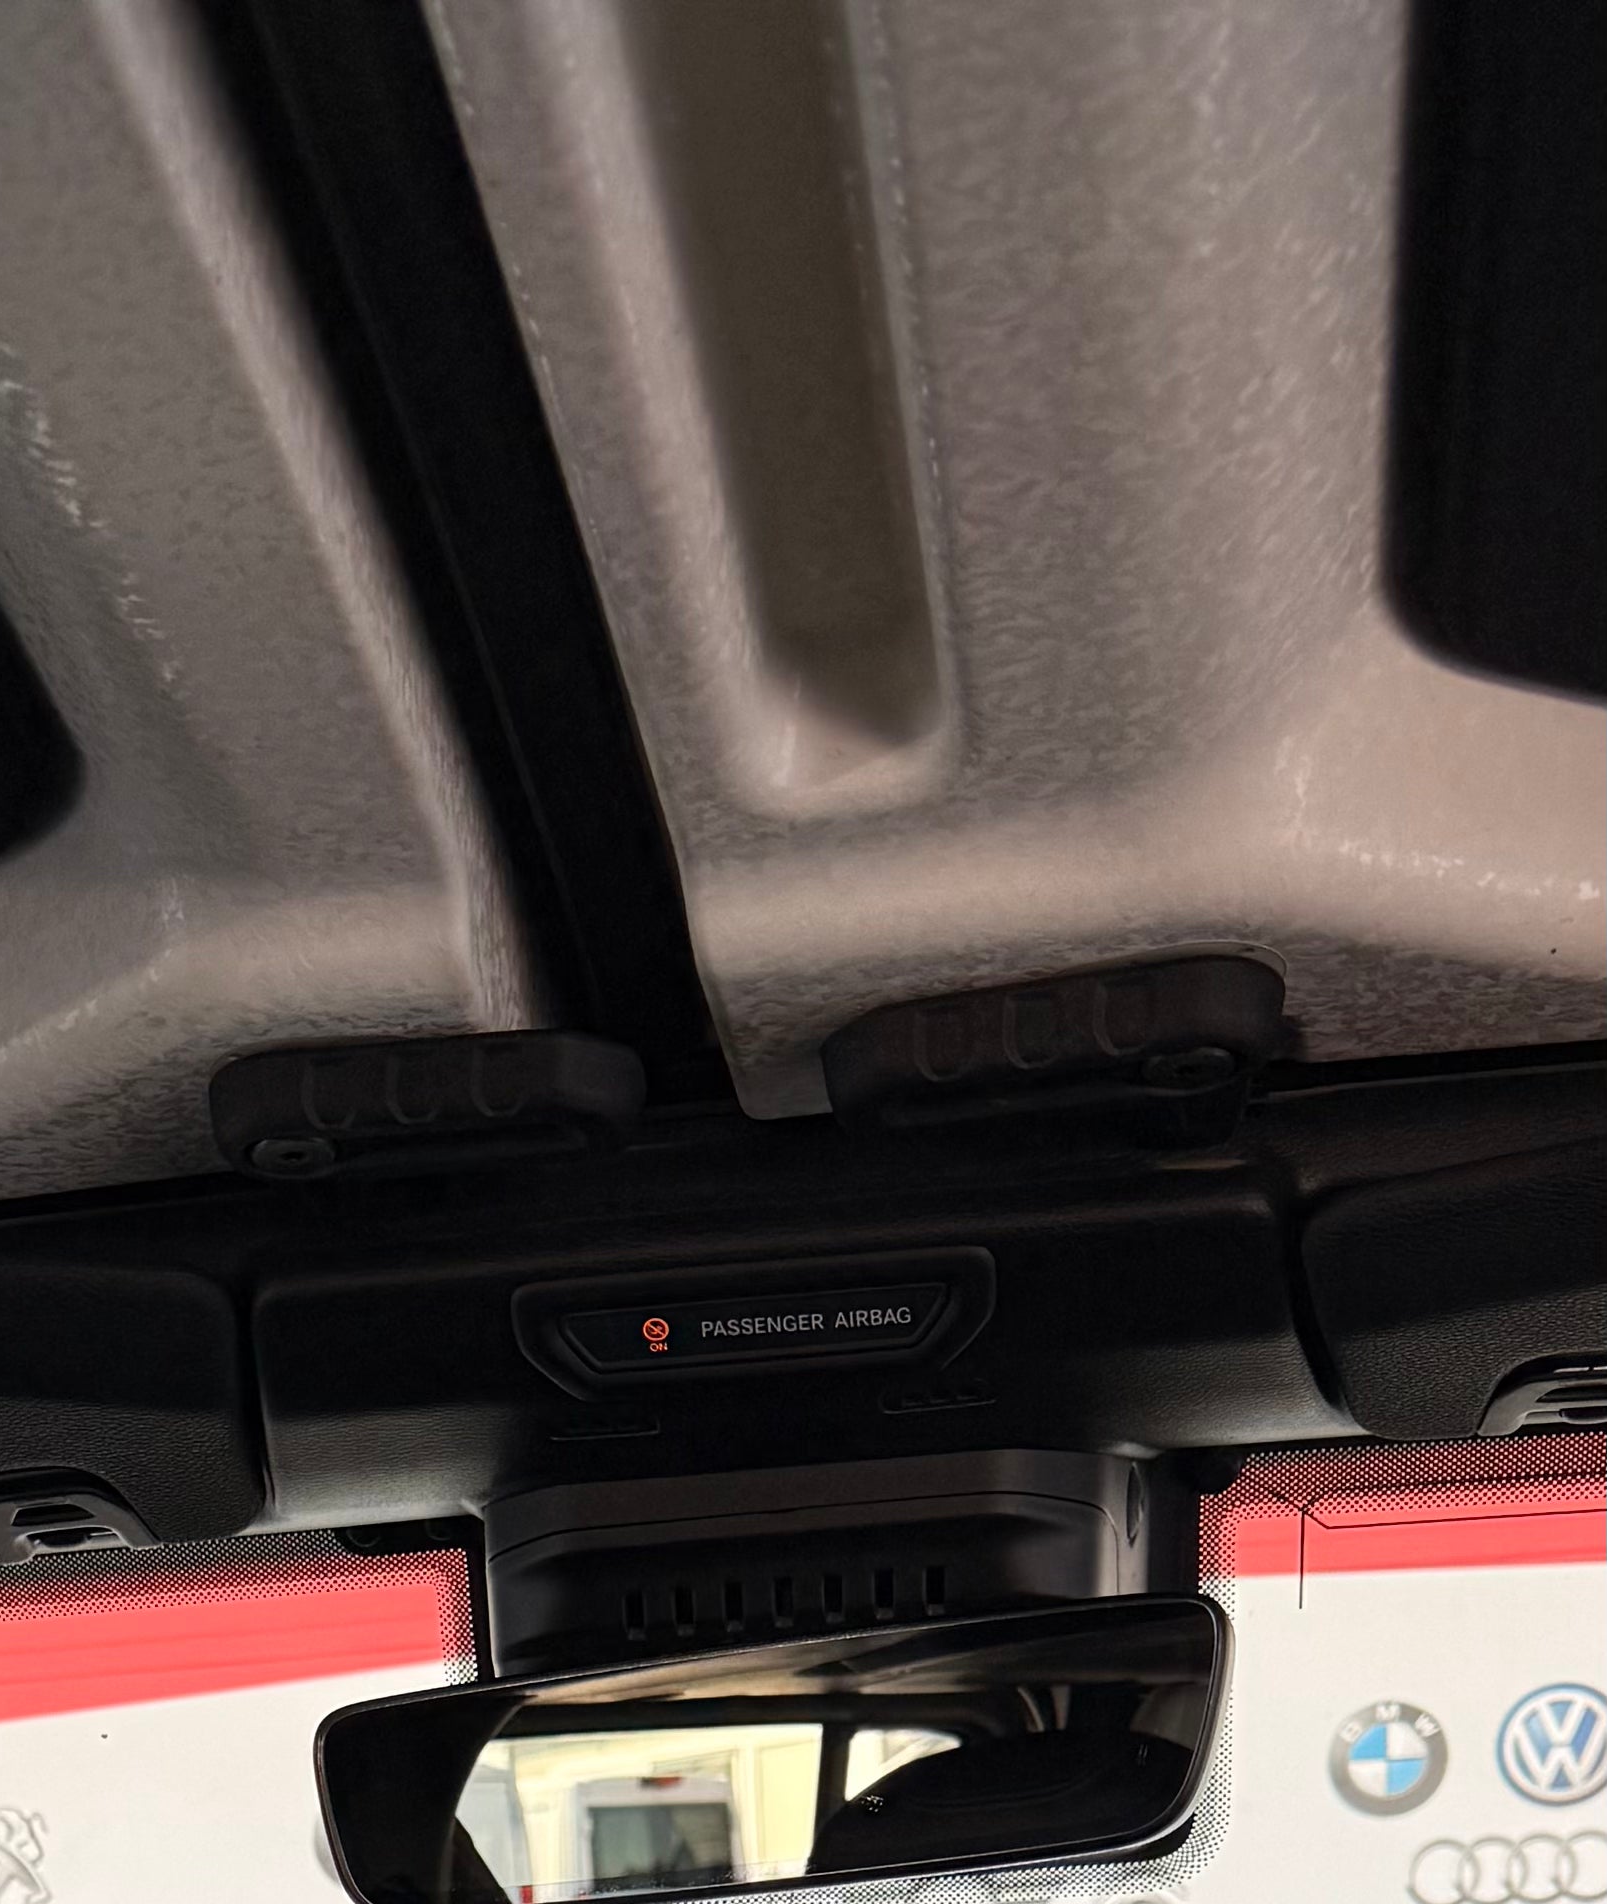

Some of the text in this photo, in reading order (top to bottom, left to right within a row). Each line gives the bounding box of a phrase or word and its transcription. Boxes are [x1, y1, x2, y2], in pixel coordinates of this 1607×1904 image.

[700, 1306, 912, 1338] PASSENGER AIRBAG
[649, 1342, 668, 1352] ON
